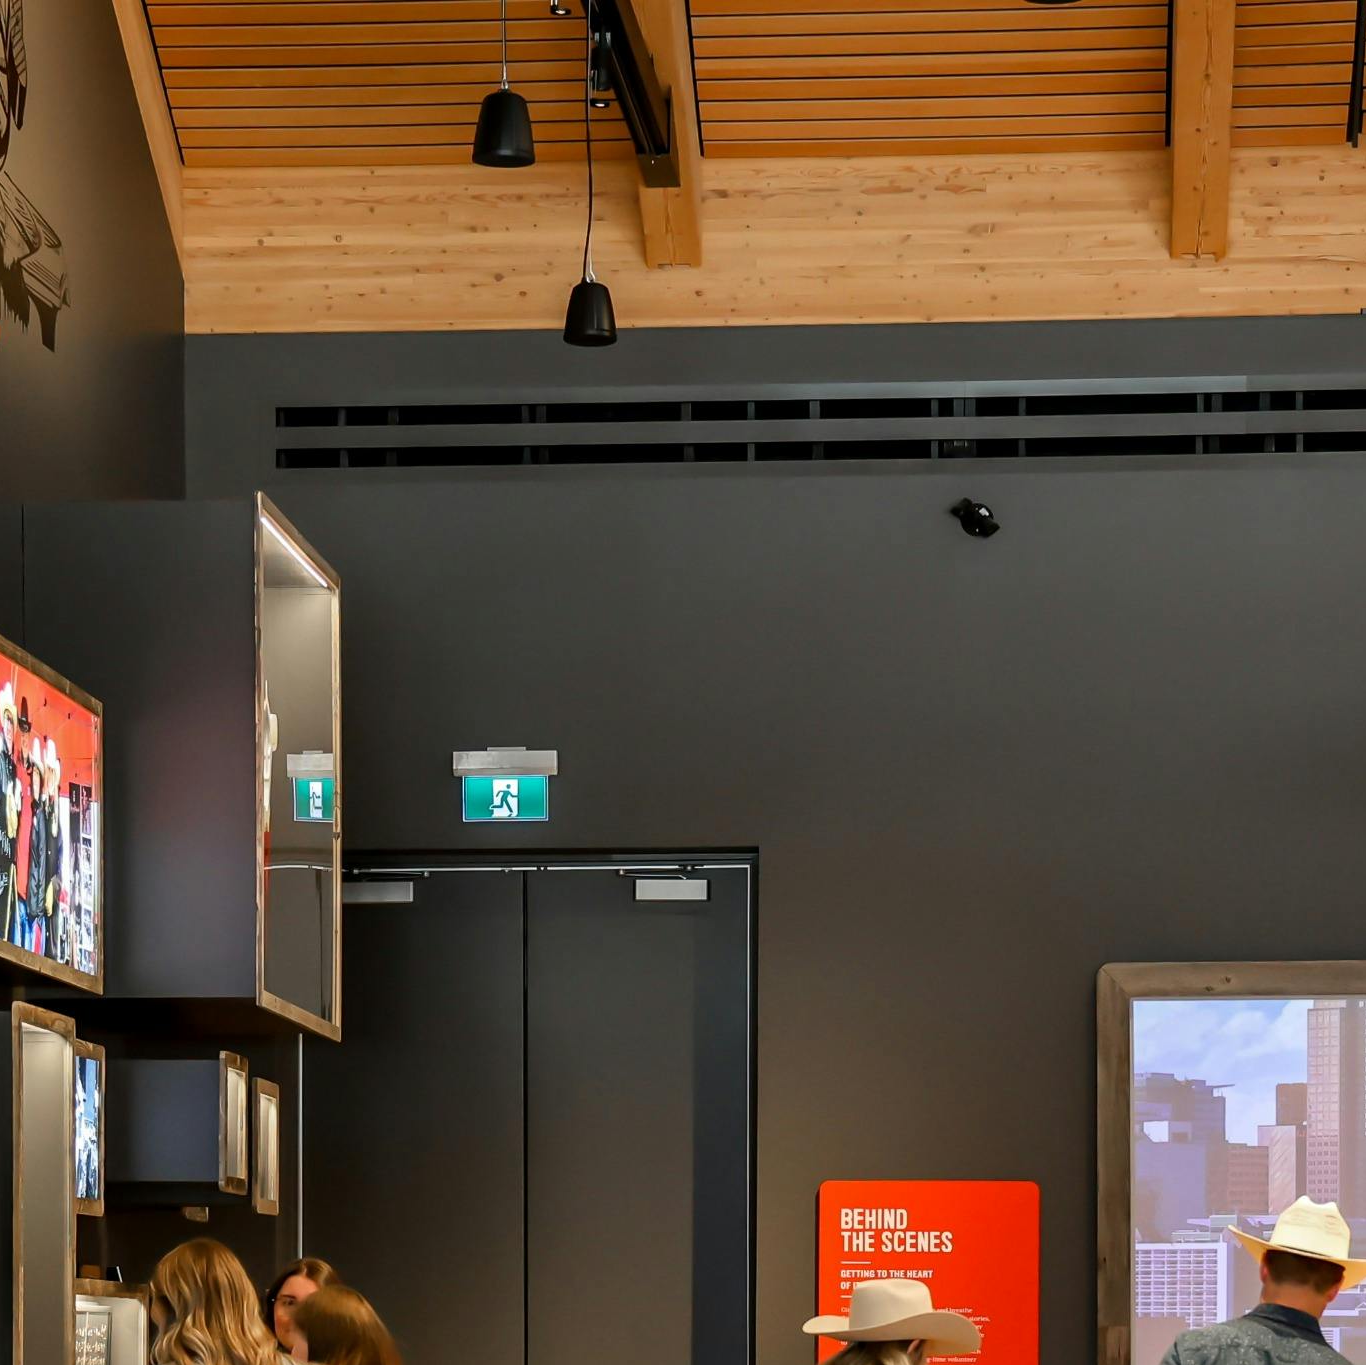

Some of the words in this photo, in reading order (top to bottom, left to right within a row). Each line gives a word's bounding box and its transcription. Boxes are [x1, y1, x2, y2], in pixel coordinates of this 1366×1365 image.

[840, 1208, 908, 1230] BEHIND
[841, 1231, 875, 1253] THE
[881, 1231, 953, 1253] SCENES
[840, 1269, 875, 1279] GETTING
[877, 1269, 888, 1279] TO
[889, 1269, 906, 1279] THE
[906, 1269, 934, 1279] HEART
[840, 1281, 852, 1290] OF
